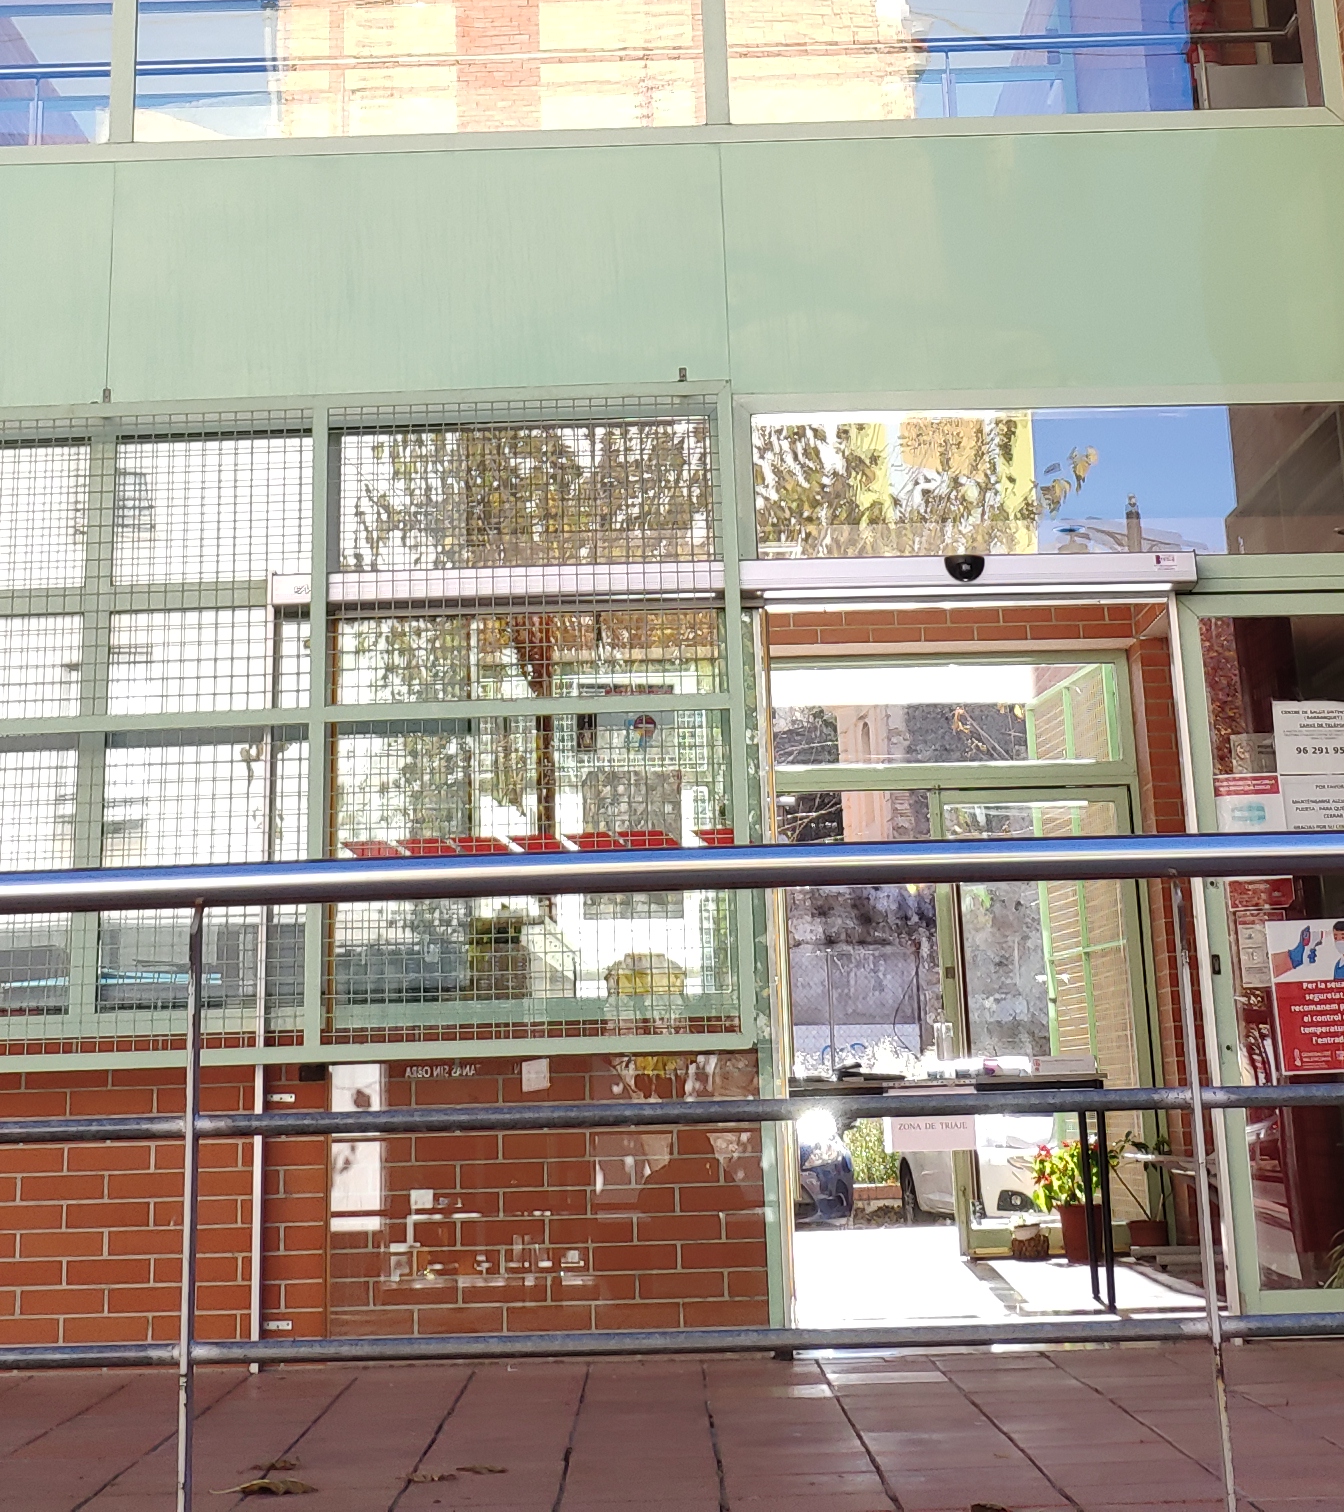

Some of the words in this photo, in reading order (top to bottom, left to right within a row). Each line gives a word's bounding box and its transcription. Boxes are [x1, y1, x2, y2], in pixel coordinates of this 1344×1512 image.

[1296, 746, 1309, 754] 96
[1311, 746, 1330, 754] 291
[1291, 1003, 1338, 1011] recomanem
[898, 1122, 922, 1131] ZONA
[924, 1122, 937, 1130] DE
[939, 1121, 968, 1131] TRIAJE
